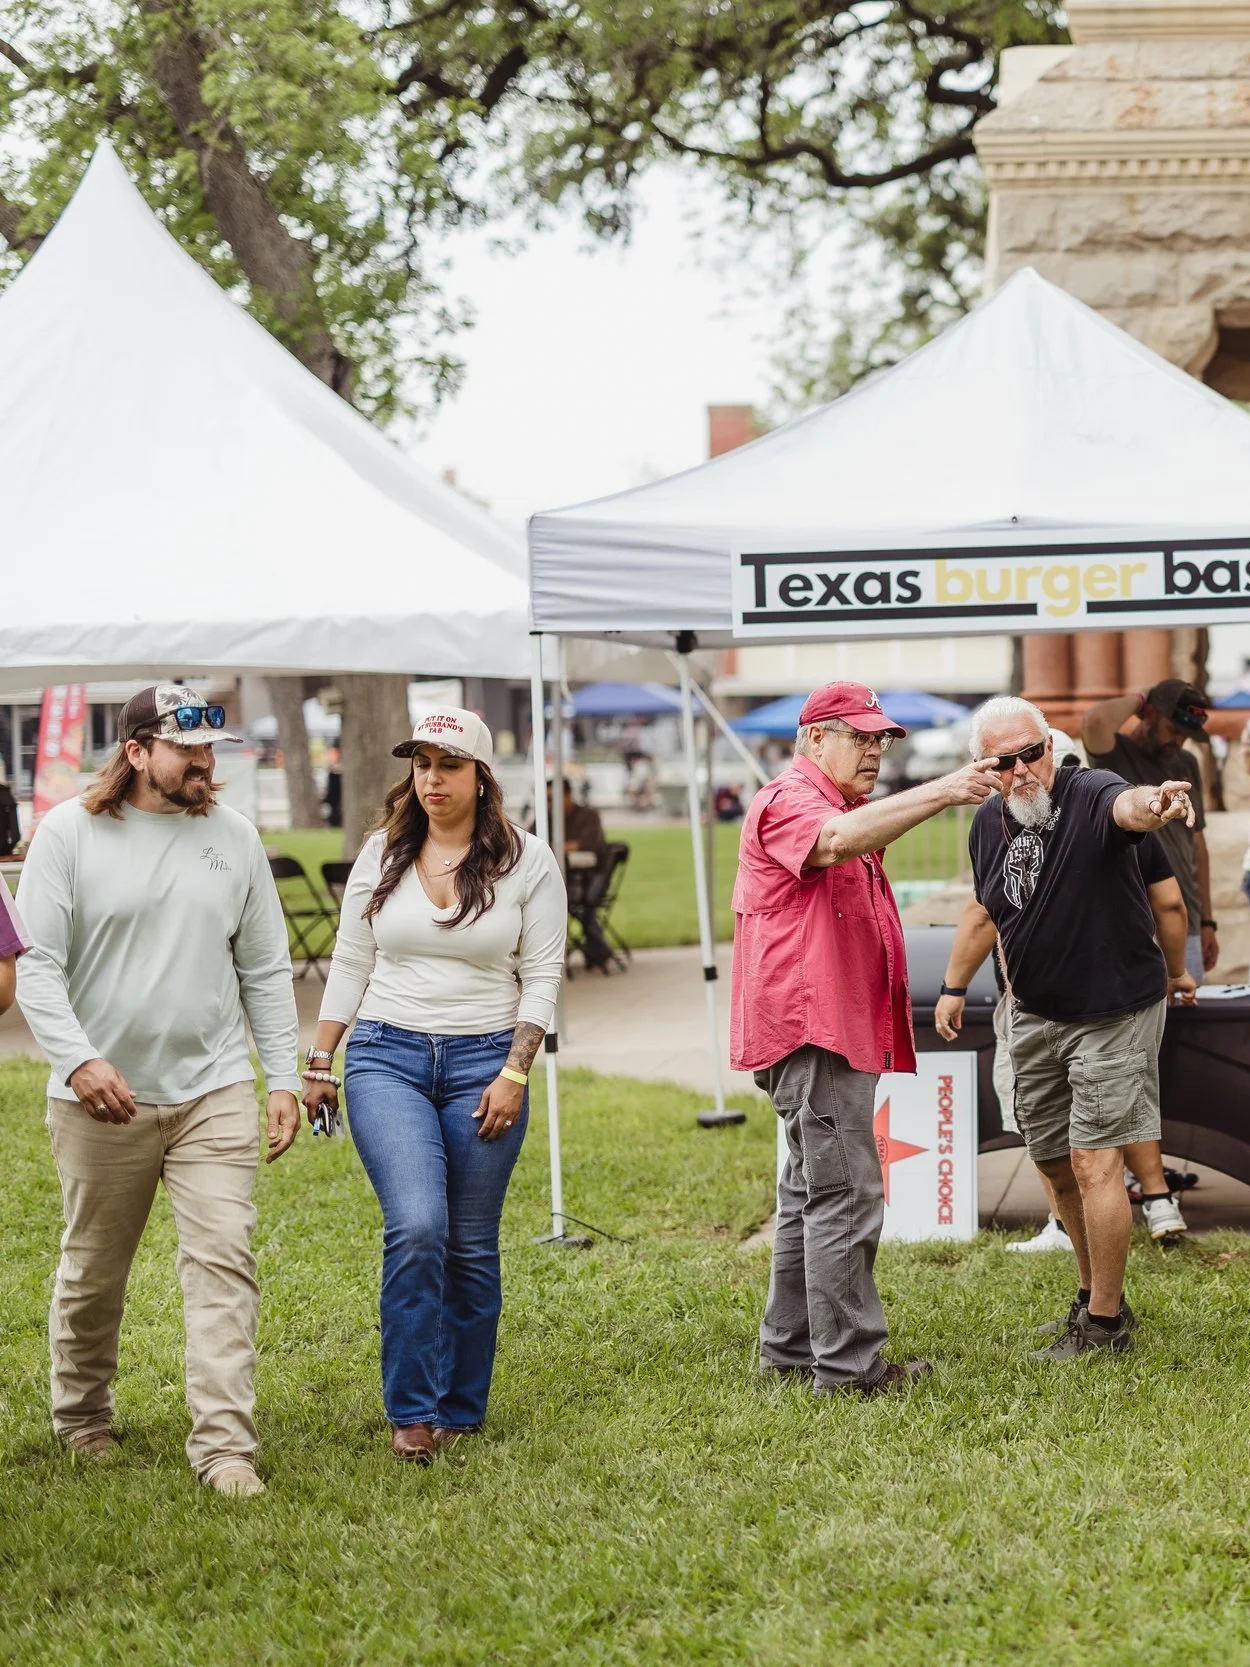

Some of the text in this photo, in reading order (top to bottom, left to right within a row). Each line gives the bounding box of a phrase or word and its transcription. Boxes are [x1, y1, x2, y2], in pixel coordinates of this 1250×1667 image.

[741, 554, 922, 608] Texas
[935, 557, 1147, 617] burger
[424, 715, 436, 723] PUT
[446, 716, 457, 724] ON
[425, 721, 464, 733] HUSBAND'S
[938, 1075, 953, 1225] PEOPLE'S CHOICE
